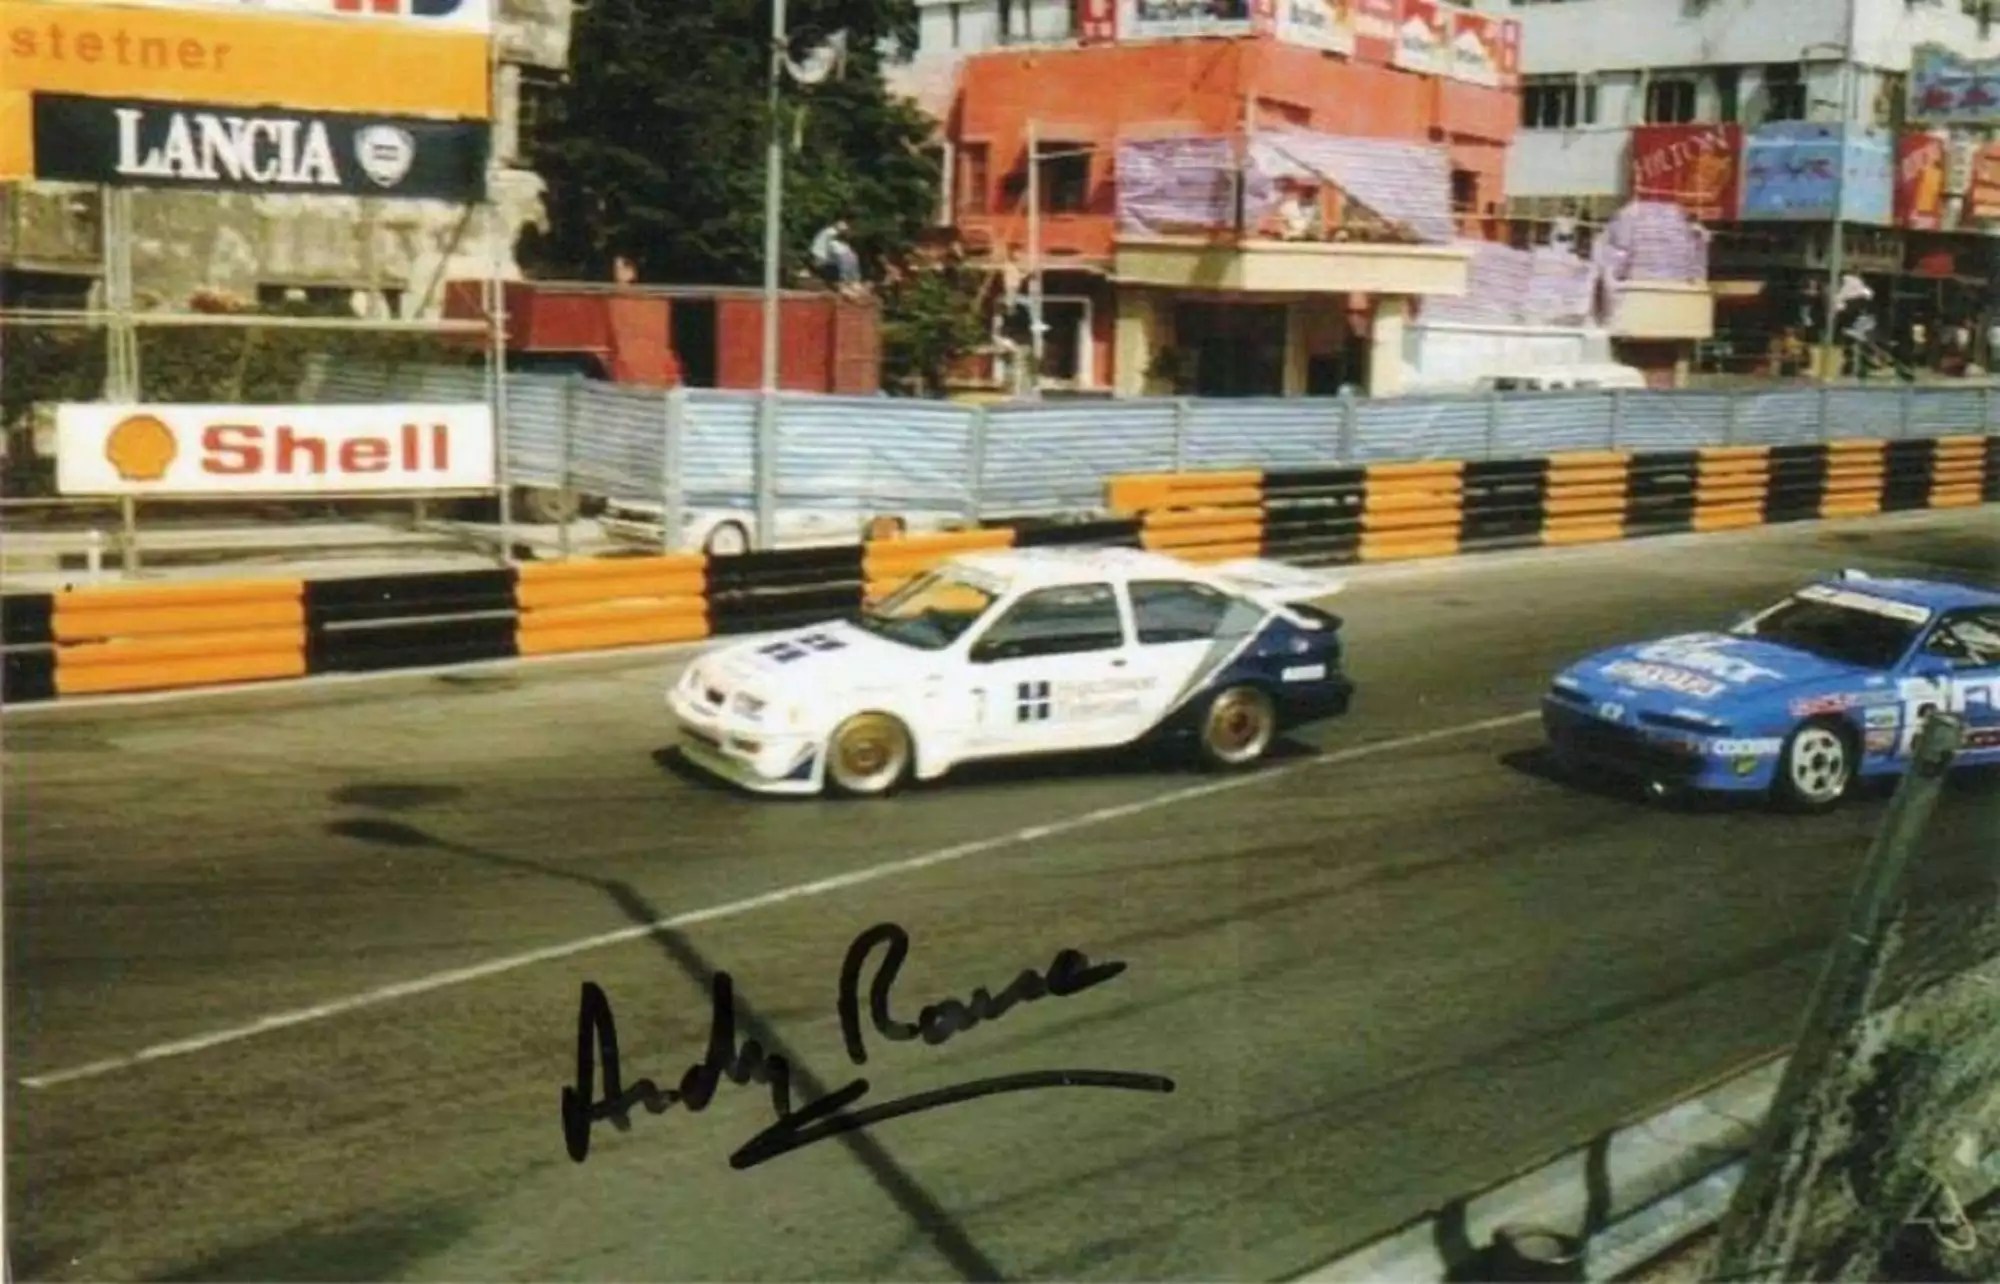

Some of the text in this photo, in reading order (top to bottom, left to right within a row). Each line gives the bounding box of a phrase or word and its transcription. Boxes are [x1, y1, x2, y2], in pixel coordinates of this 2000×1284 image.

[8, 21, 233, 73] stetner
[115, 109, 341, 185] LANCIA
[201, 424, 450, 475] Shell
